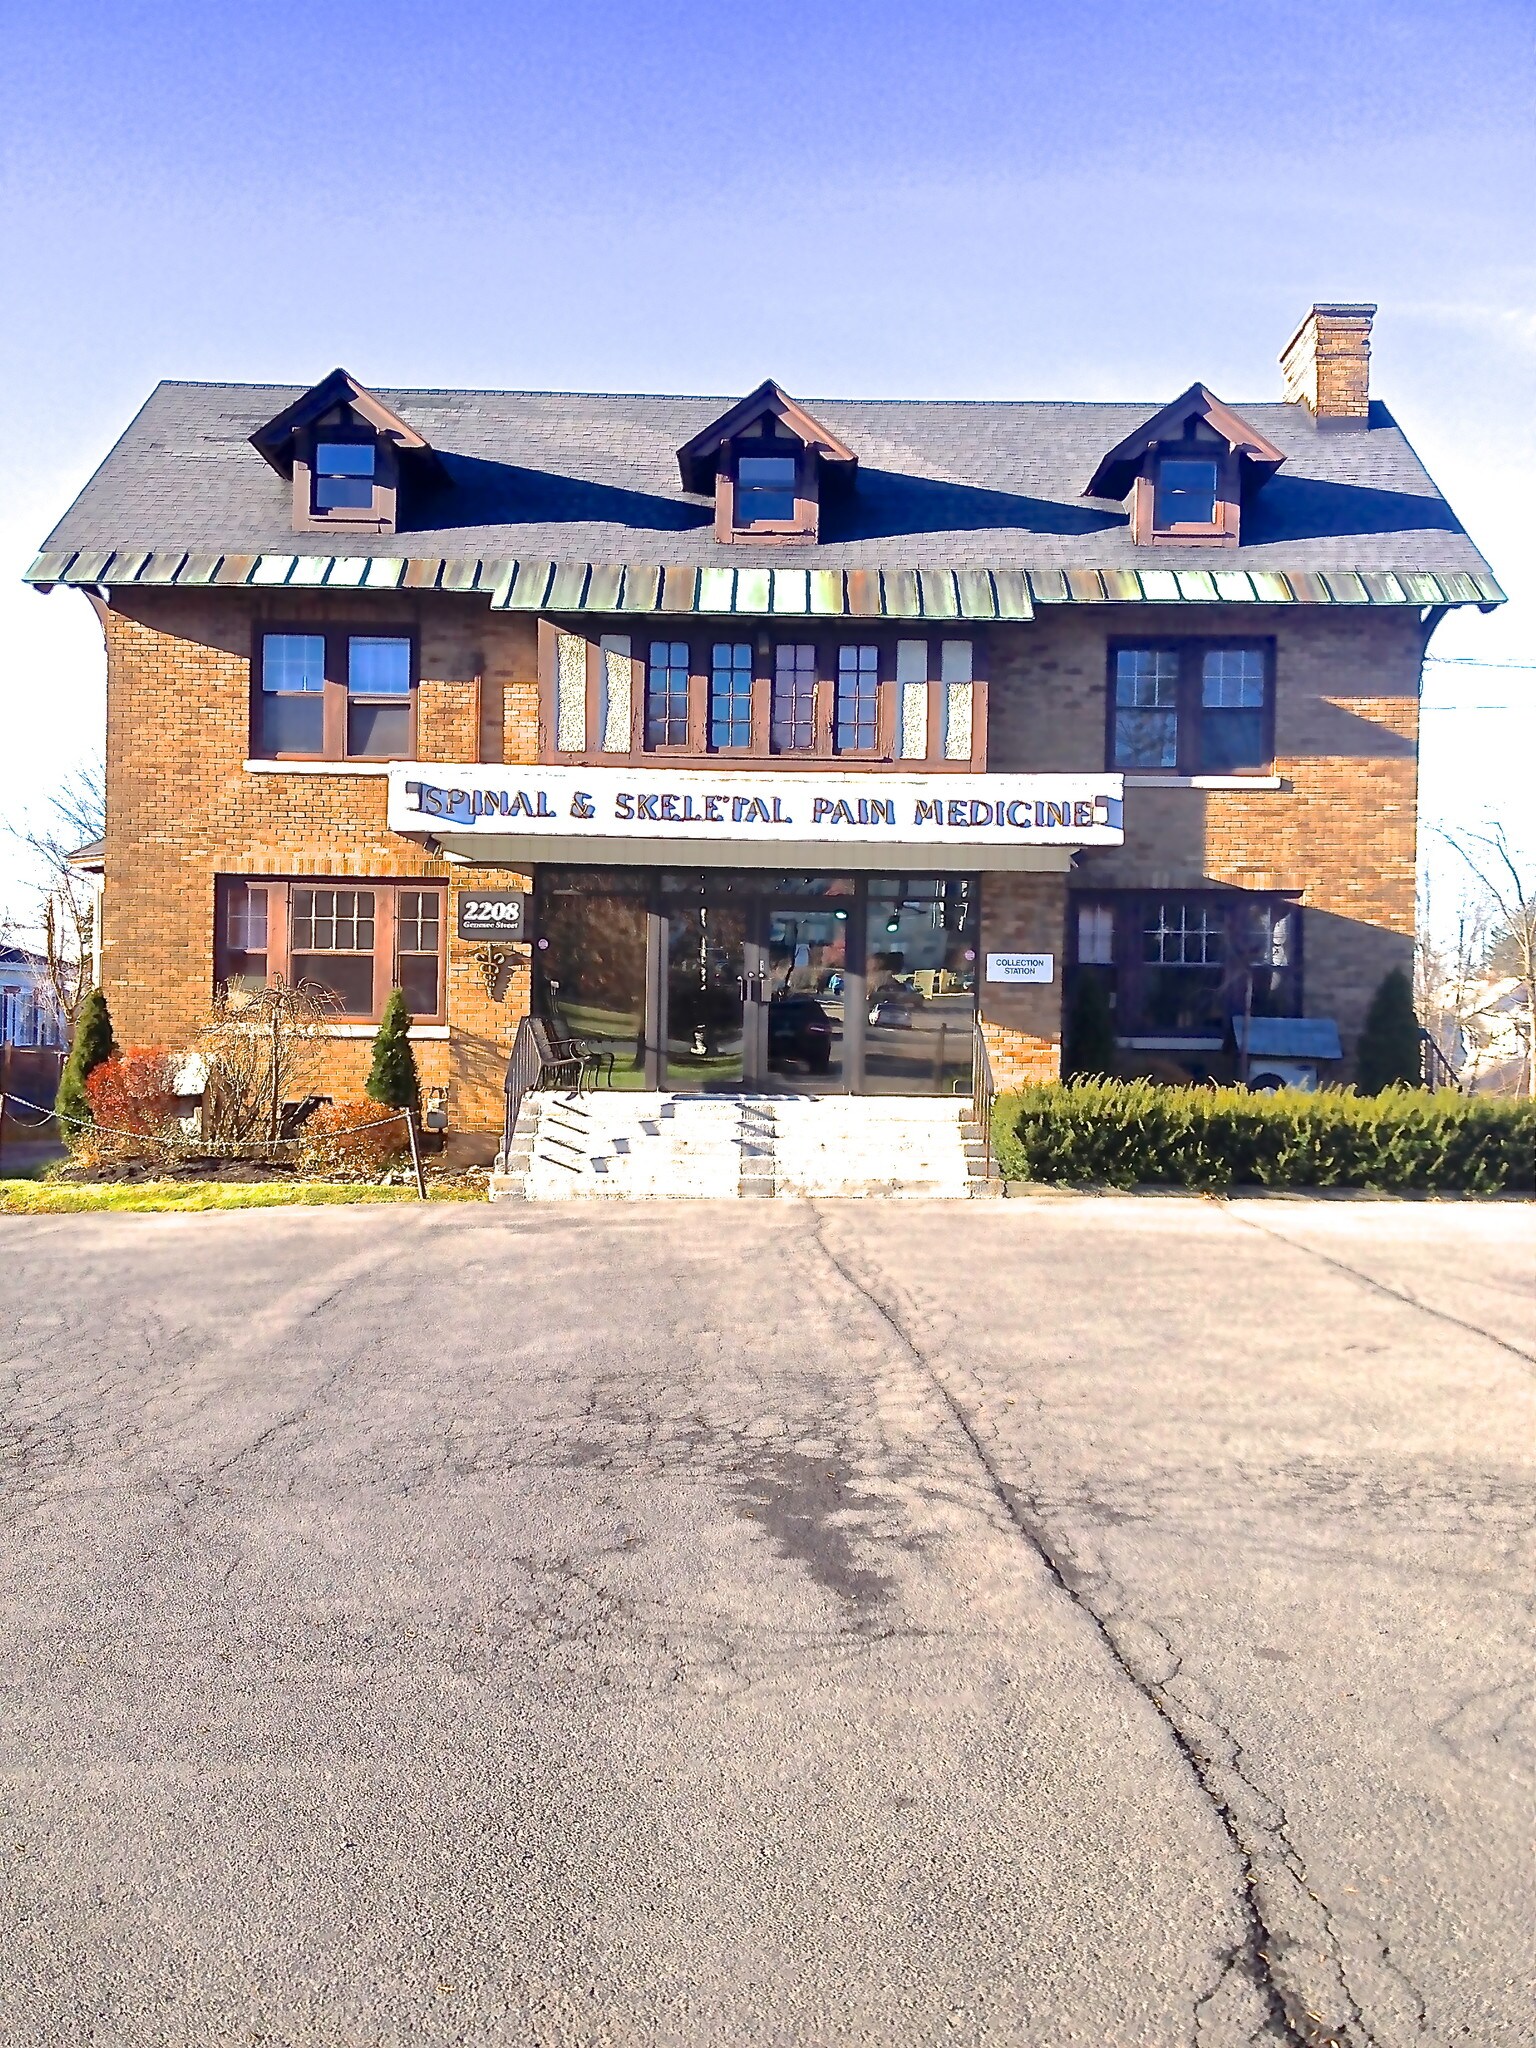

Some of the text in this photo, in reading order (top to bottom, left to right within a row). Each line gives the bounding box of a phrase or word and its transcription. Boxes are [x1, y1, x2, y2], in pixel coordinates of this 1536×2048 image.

[423, 787, 1095, 828] SPINAL & SKELETAL PAIN MEDICINE
[463, 901, 520, 921] 2208
[495, 921, 518, 929] Street
[995, 959, 1044, 967] COLLECTION
[1004, 967, 1036, 975] STATION
